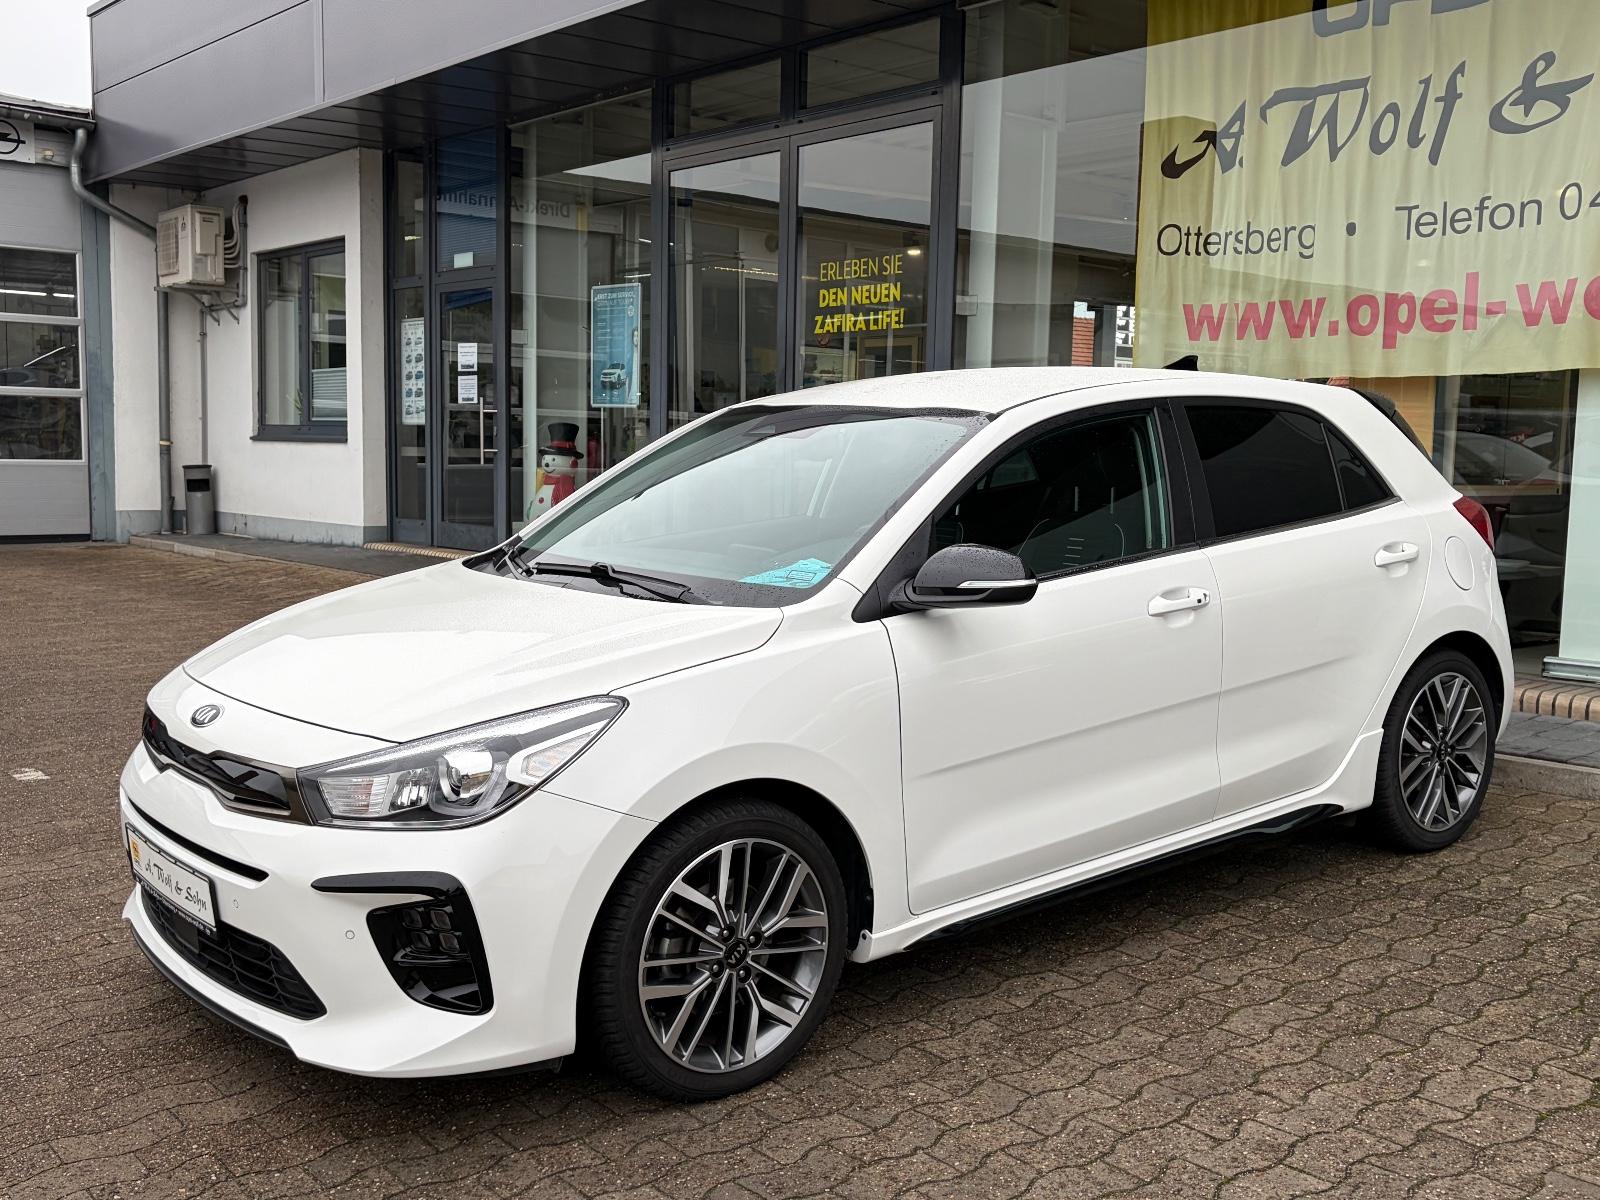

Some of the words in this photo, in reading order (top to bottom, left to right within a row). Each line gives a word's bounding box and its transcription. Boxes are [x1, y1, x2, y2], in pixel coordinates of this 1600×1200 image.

[1161, 99, 1246, 179] A.
[1260, 61, 1467, 168] Wolf
[1489, 50, 1596, 135] &
[1157, 222, 1317, 260] Ottersberg
[1395, 195, 1544, 241] Telefon
[820, 256, 879, 281] ERLEBEN
[882, 254, 904, 276] SIE
[819, 286, 848, 308] DEN
[851, 282, 901, 306] NEUEN
[814, 311, 867, 334] ZAFIRA
[869, 308, 905, 330] LIFE!
